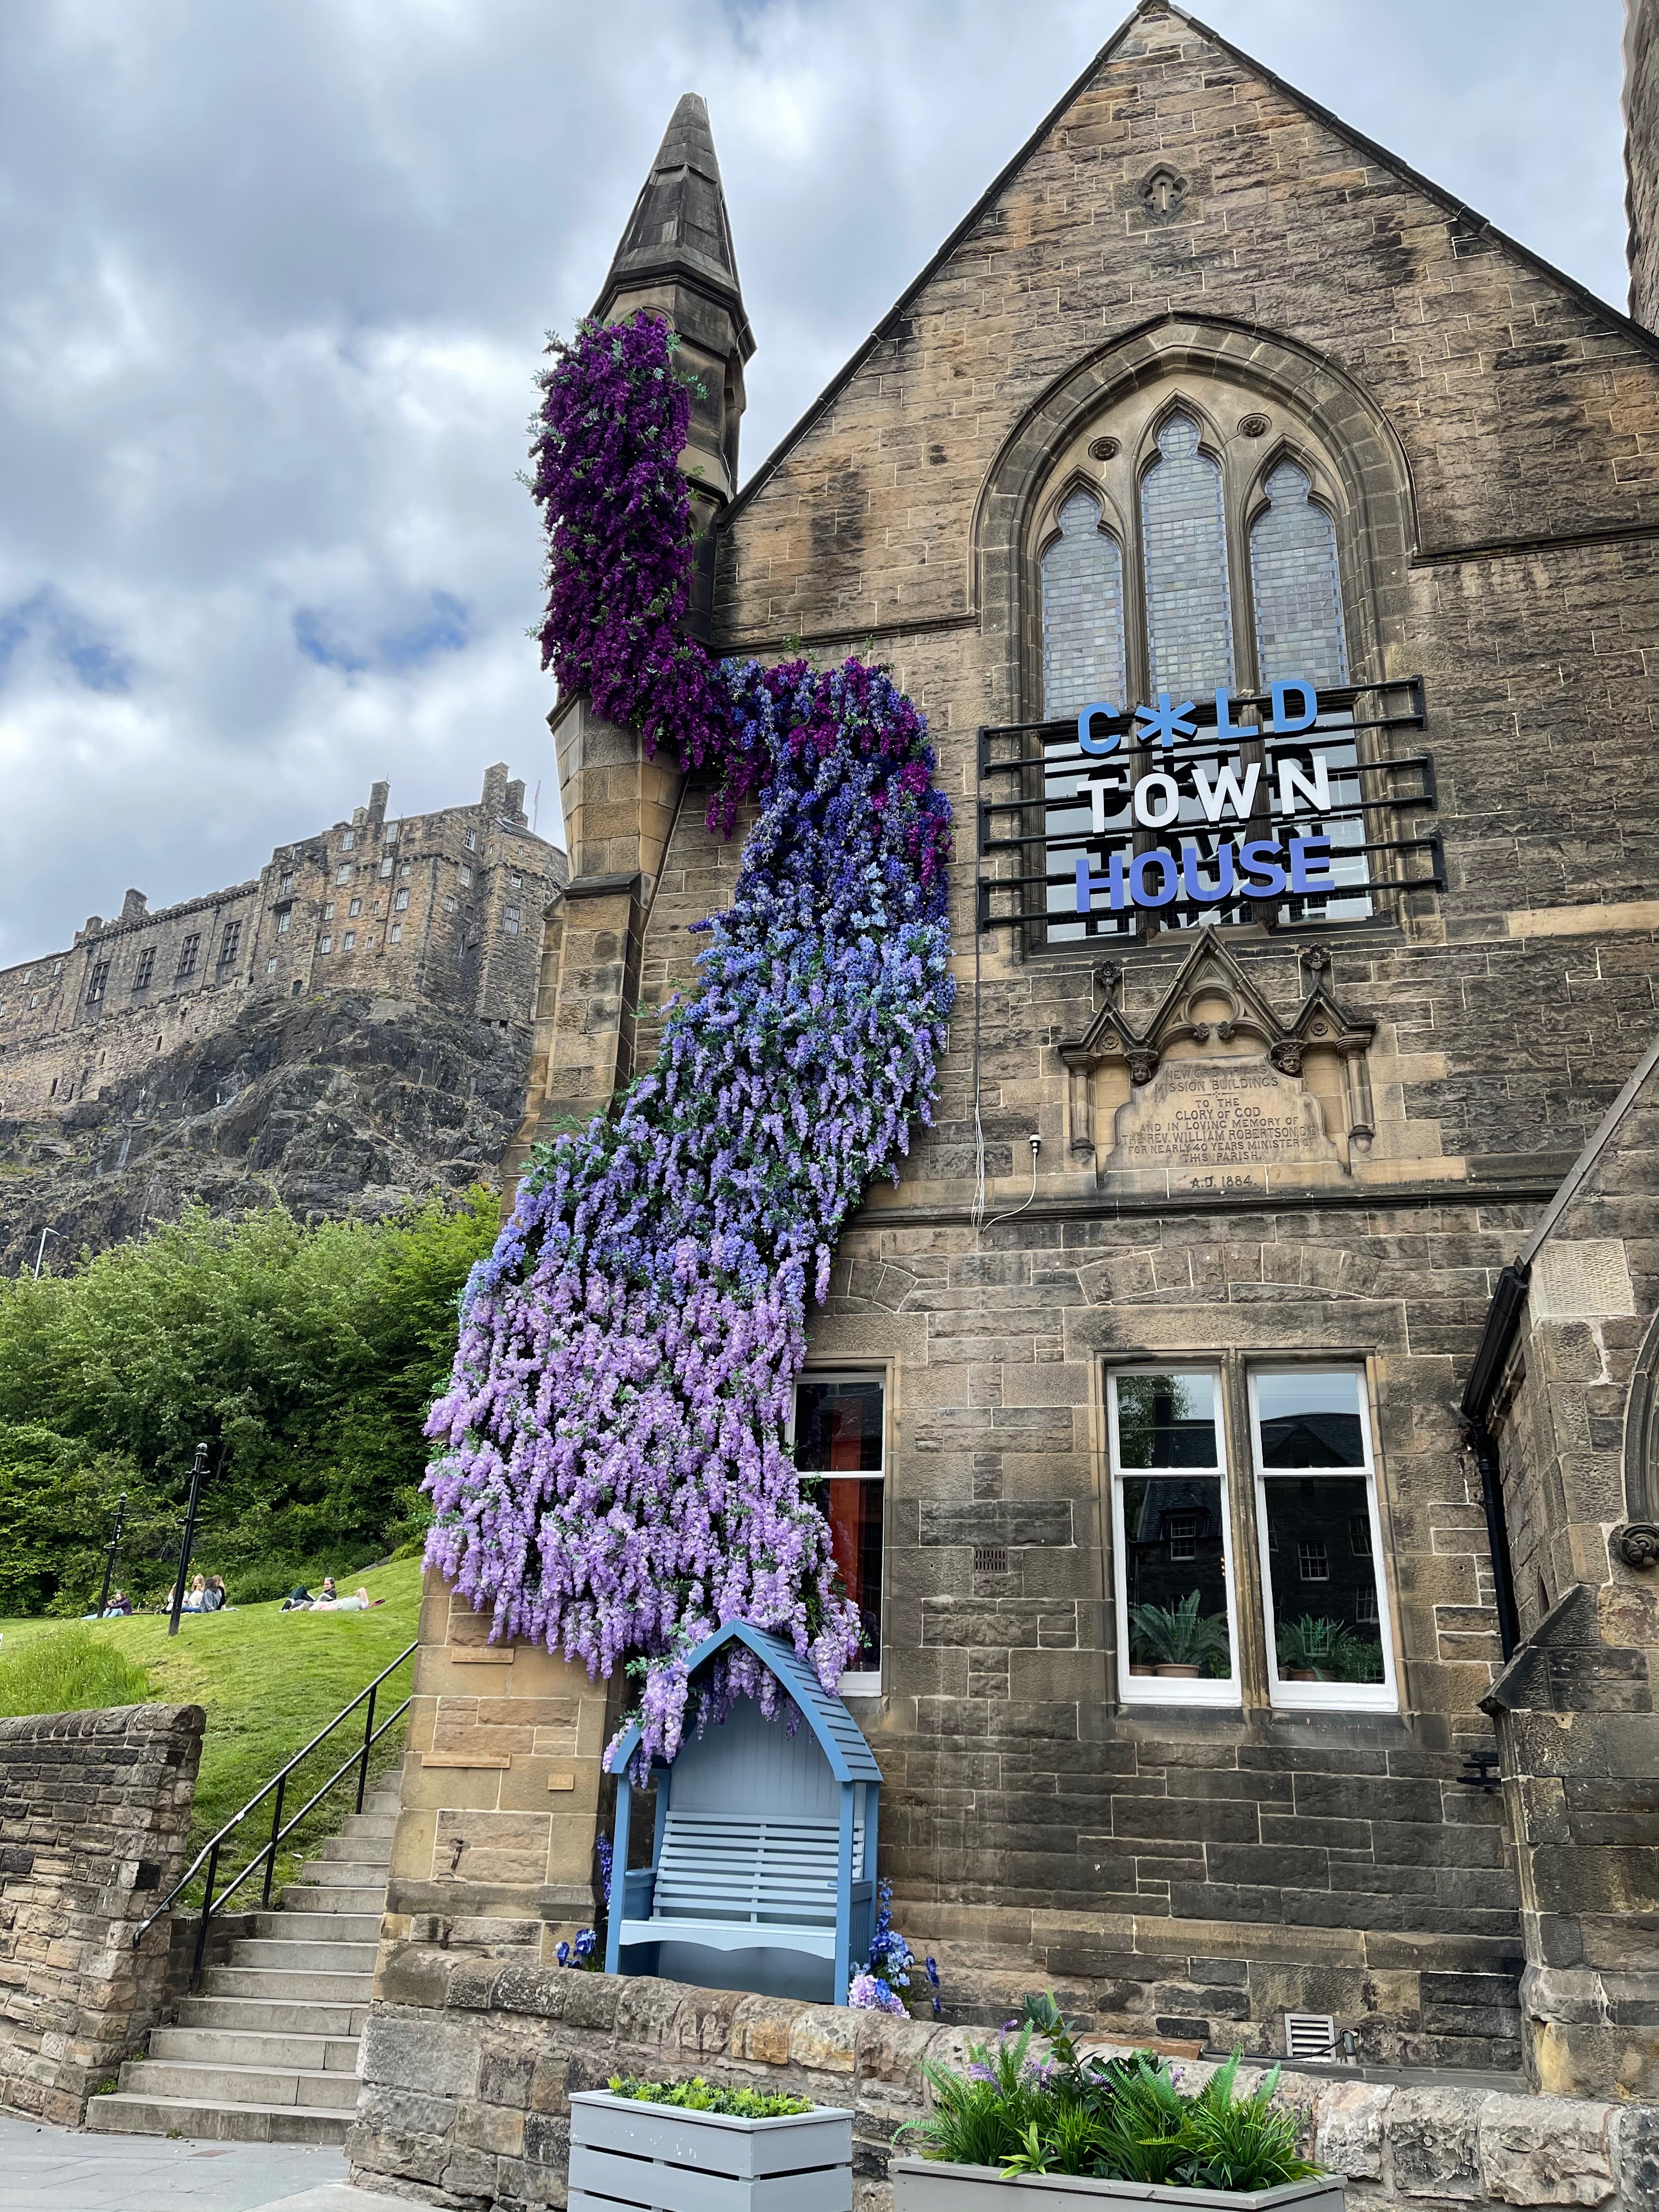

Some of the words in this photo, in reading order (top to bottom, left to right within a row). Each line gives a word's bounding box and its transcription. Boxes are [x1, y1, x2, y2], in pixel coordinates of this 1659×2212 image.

[1076, 755, 1331, 833] TOWN
[1076, 835, 1335, 913] HOUSE
[1165, 1069, 1190, 1080] NEW
[1194, 1064, 1267, 1078] GREYFRIARS
[1155, 1081, 1206, 1093] MISSION
[1212, 1077, 1279, 1090] BUILDINGS
[1195, 1099, 1209, 1108] TO
[1217, 1098, 1240, 1107] THE
[1175, 1109, 1214, 1120] GLORY
[1217, 1110, 1231, 1119] OF
[1234, 1107, 1261, 1118] GOD
[1139, 1123, 1161, 1132] AND
[1167, 1122, 1179, 1131] IN
[1186, 1120, 1227, 1130] LOVING
[1232, 1118, 1281, 1128] MEMORY
[1285, 1116, 1299, 1125] OF
[1122, 1133, 1144, 1145] THE
[1147, 1132, 1171, 1144] REV.
[1173, 1130, 1224, 1143] WILLIAM
[1128, 1146, 1147, 1155] FOR
[1150, 1143, 1191, 1154] NEARLY
[1193, 1143, 1208, 1152] 40
[1211, 1141, 1245, 1152] YEARS
[1247, 1139, 1300, 1150] MINISTER
[1302, 1138, 1315, 1147] OF
[1182, 1153, 1209, 1163] THIS
[1216, 1151, 1262, 1161] PARISH.
[1192, 1177, 1216, 1188] A.D.
[1222, 1175, 1257, 1187] 1884.
